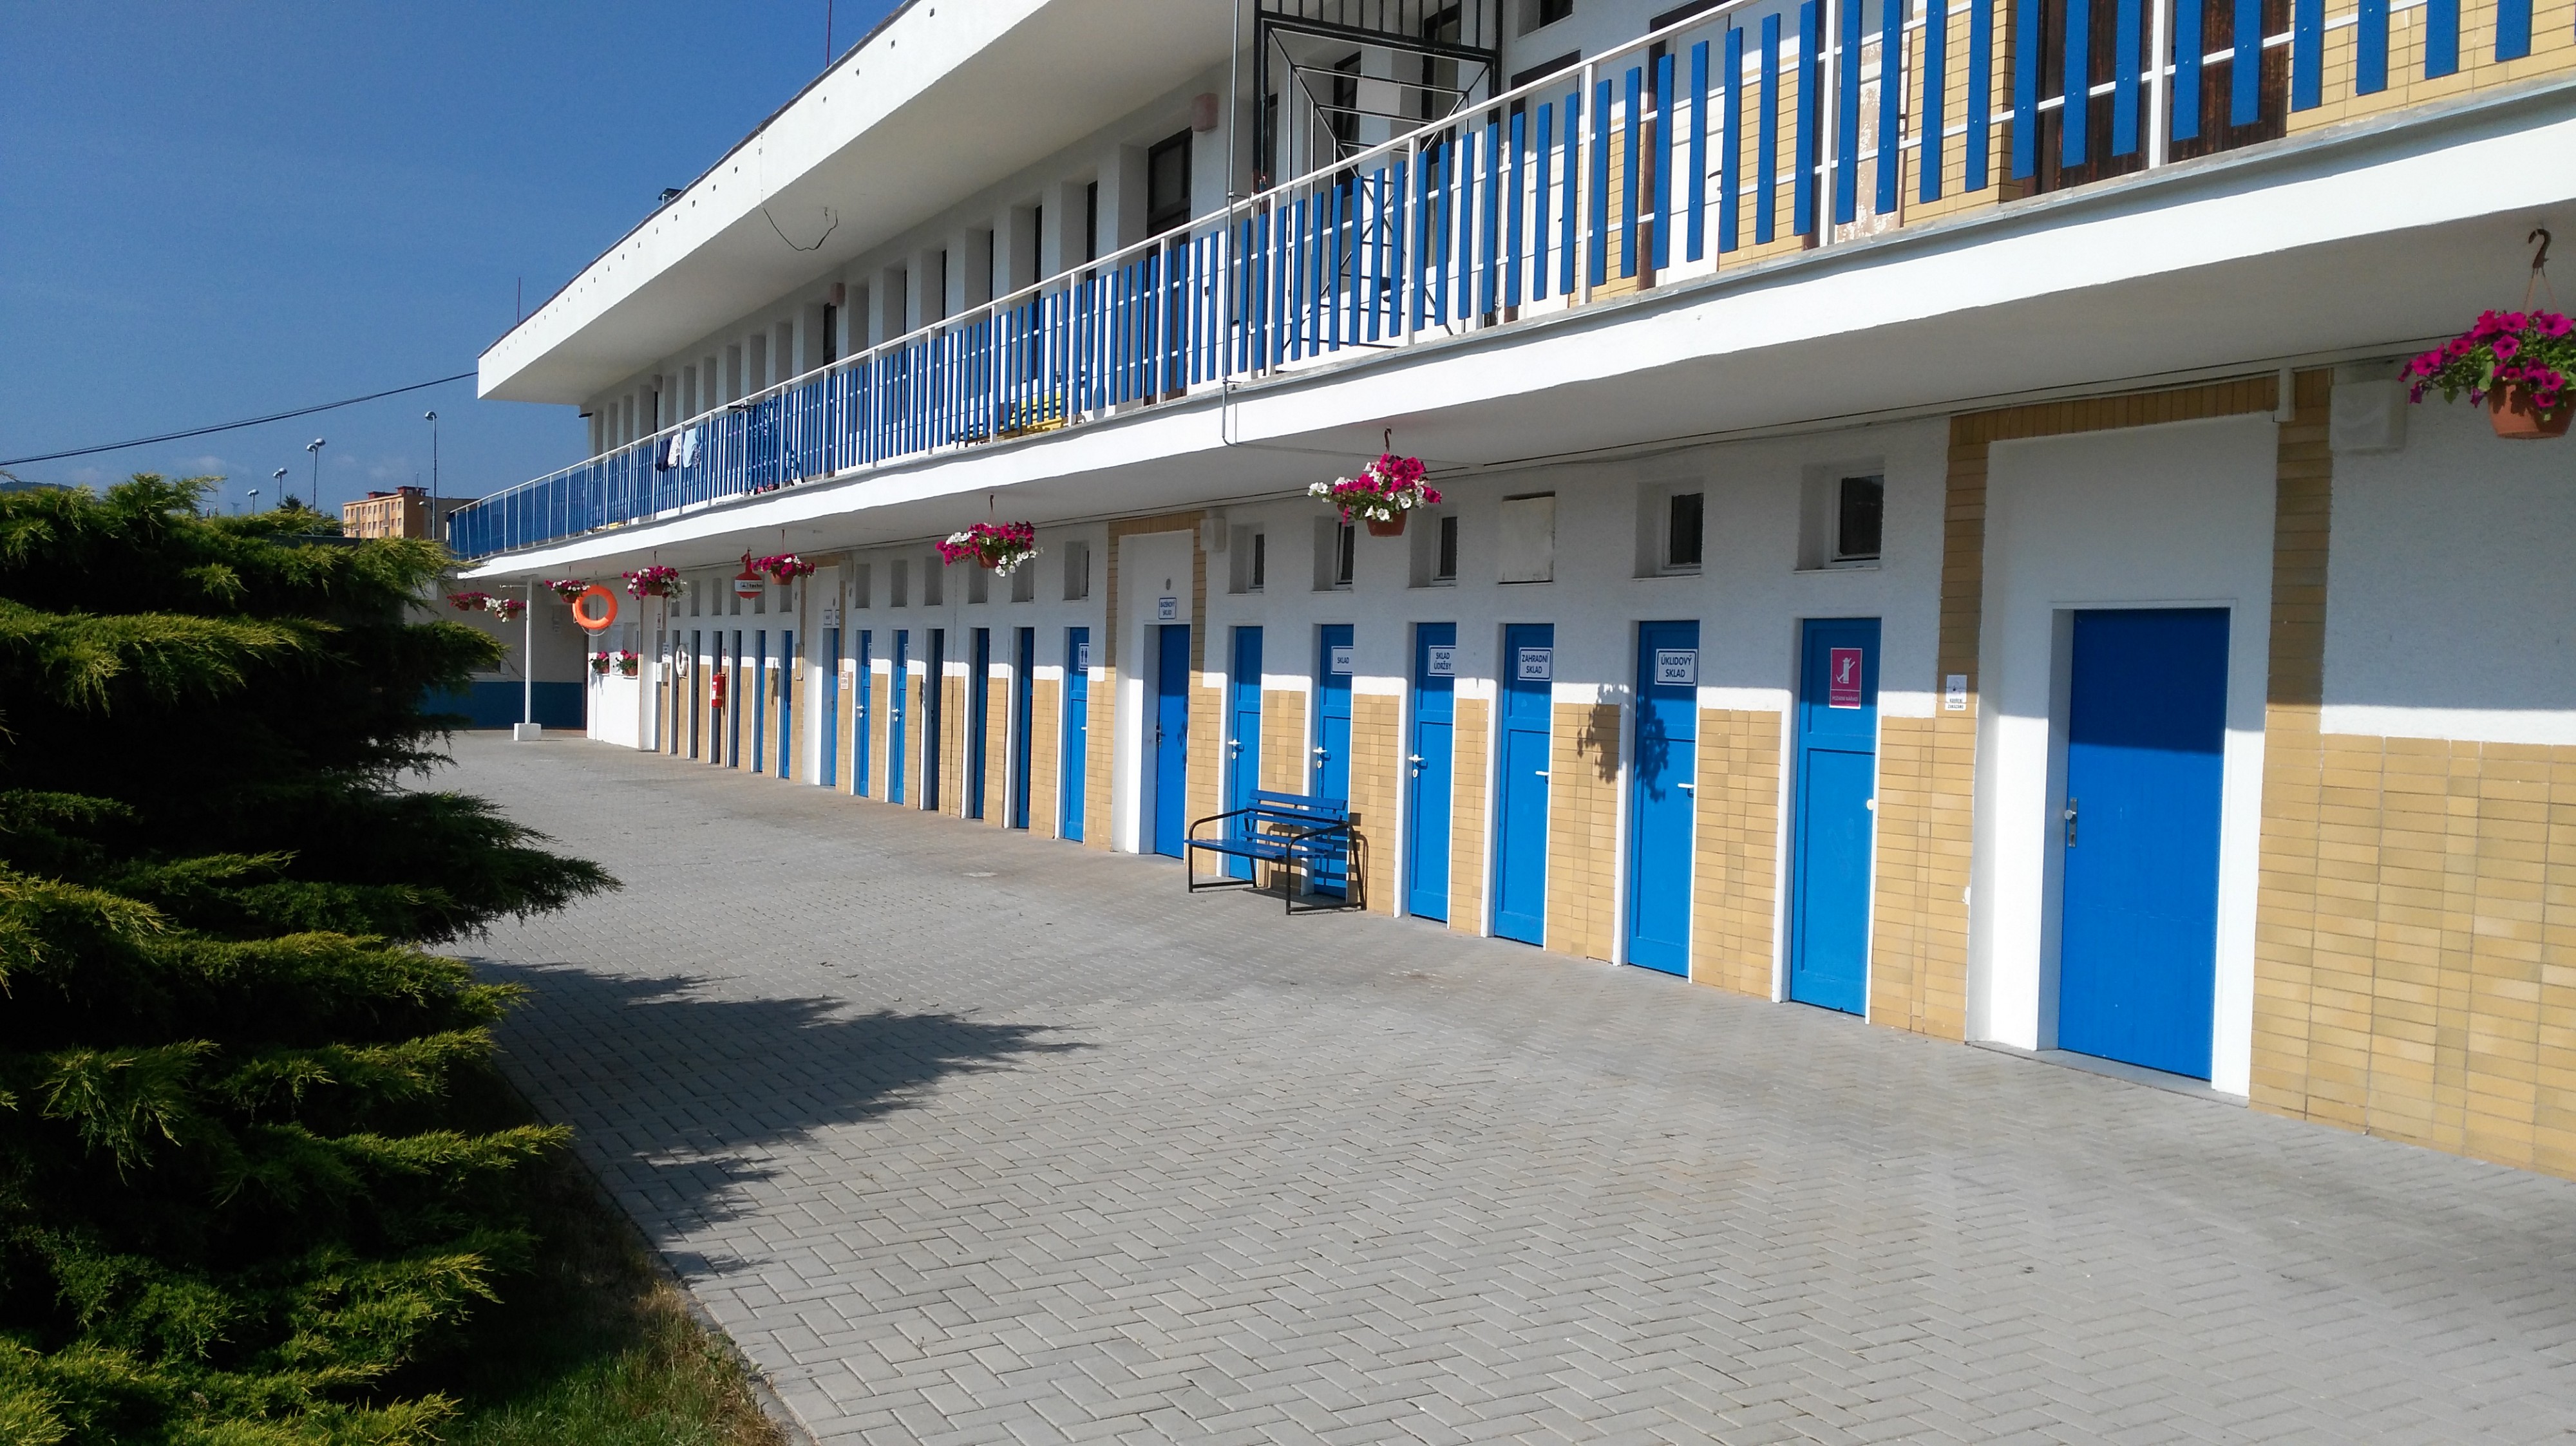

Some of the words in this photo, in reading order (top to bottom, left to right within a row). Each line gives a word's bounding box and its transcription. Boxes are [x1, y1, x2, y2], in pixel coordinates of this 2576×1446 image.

[1522, 653, 1549, 663] ZAHRADNÍ
[1661, 654, 1692, 666] ÚKLIDOVÝ
[1434, 660, 1452, 670] ÚDRŽBY
[1526, 665, 1542, 674] SKLAD
[1665, 669, 1685, 678] SKLAD
